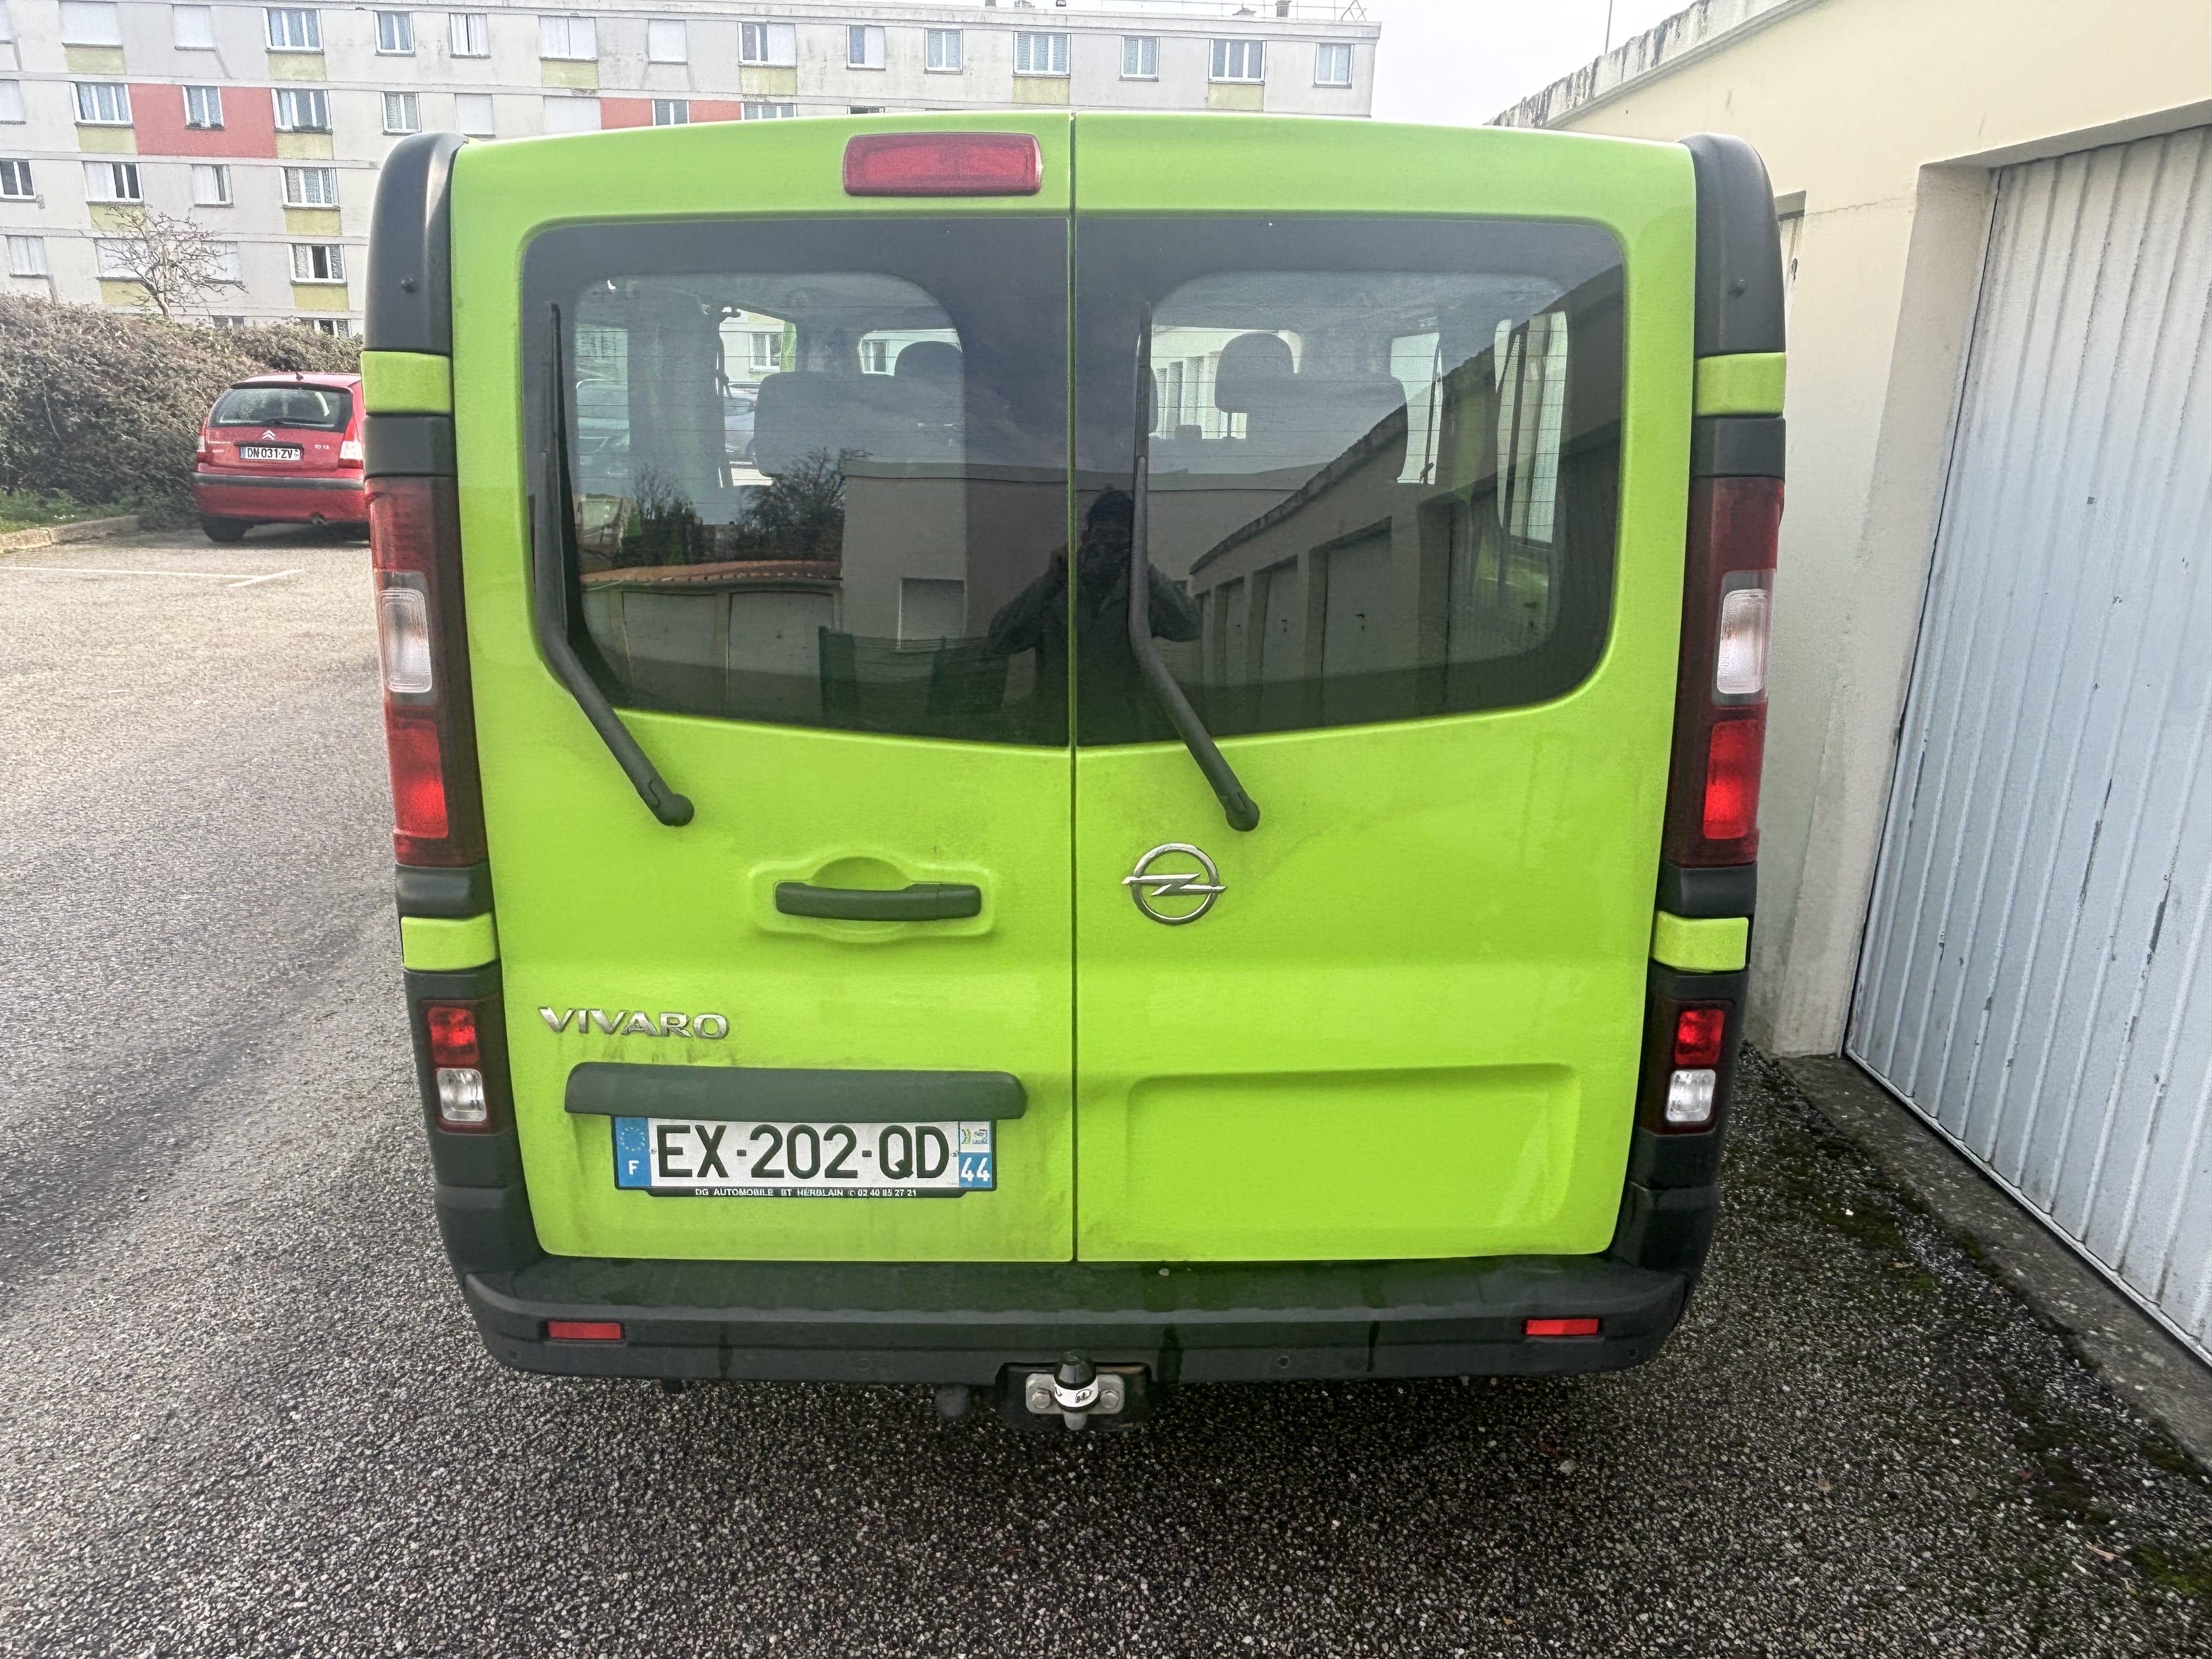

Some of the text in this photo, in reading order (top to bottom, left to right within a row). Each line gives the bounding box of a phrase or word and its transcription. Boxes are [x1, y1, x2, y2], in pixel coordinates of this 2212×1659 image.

[538, 1006, 730, 1040] VIVARO
[657, 1124, 949, 1180] EX-202-QD
[628, 1160, 639, 1175] F
[961, 1157, 990, 1182] 44
[797, 1188, 843, 1197] HERBLAIN
